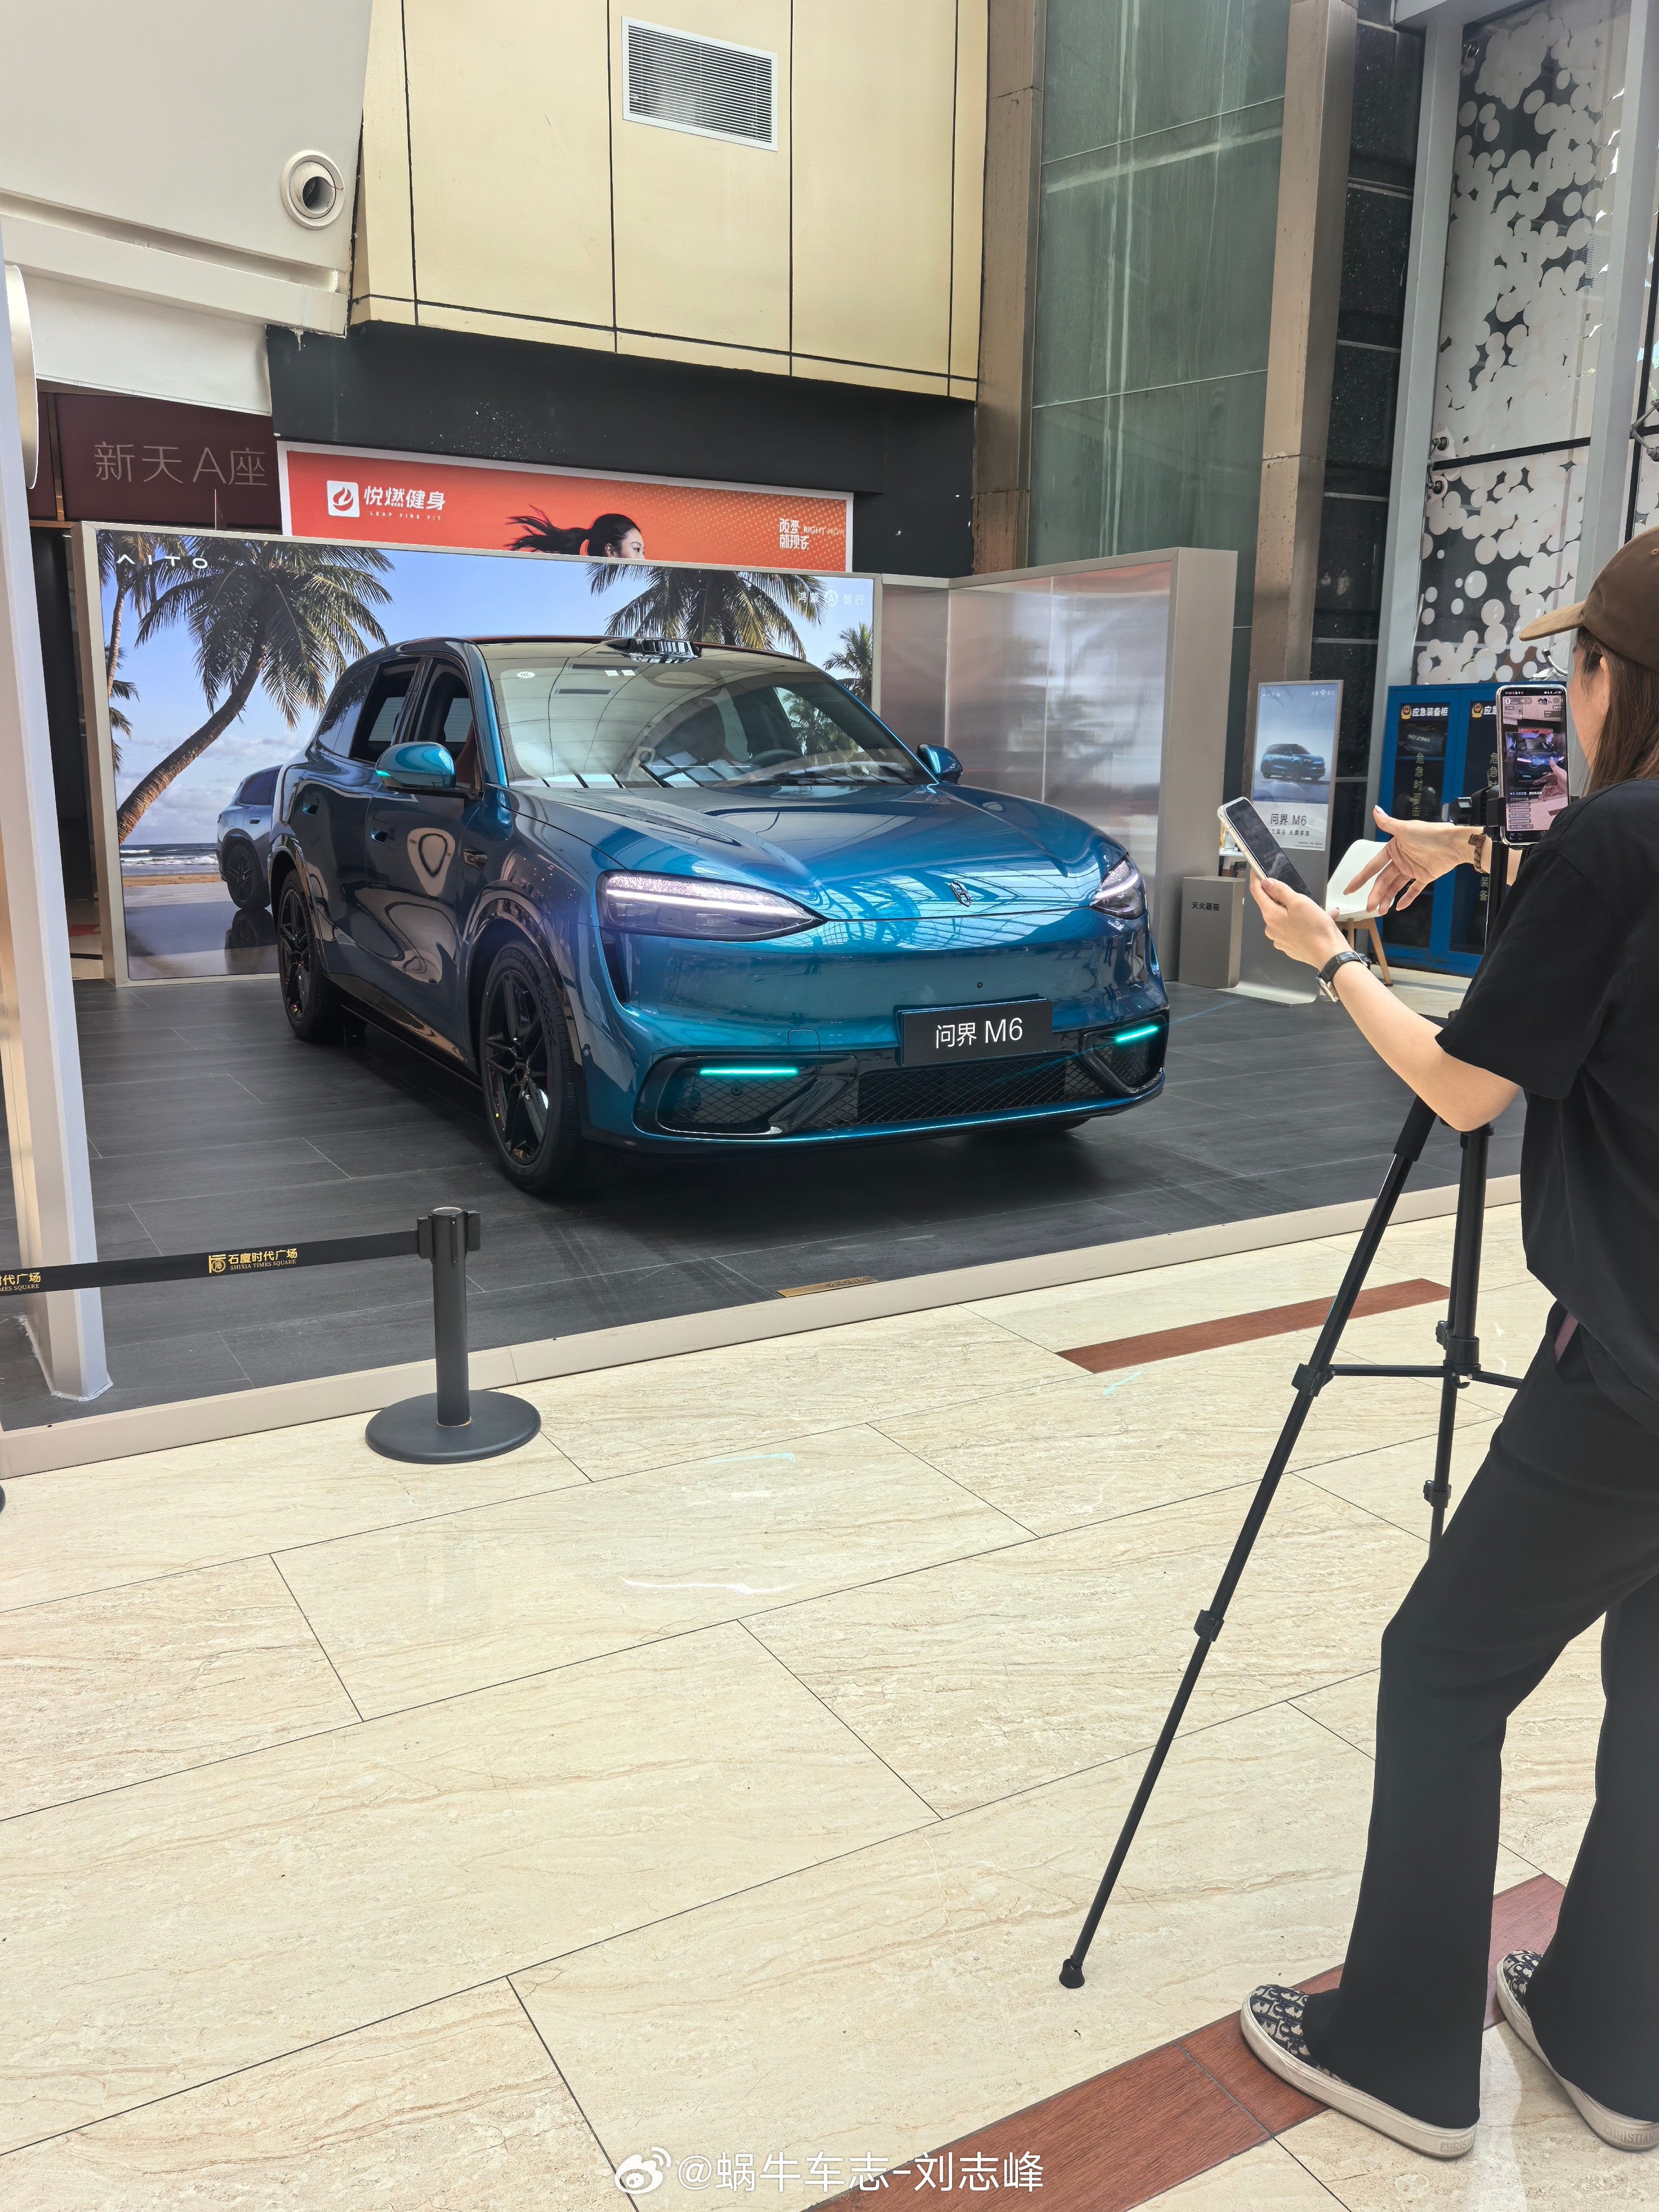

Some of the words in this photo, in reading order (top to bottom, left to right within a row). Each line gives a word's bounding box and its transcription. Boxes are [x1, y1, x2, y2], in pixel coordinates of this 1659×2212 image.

[94, 442, 268, 485] 新天A座
[363, 485, 446, 510] 悦燃健身
[779, 518, 800, 534] 改变
[803, 525, 826, 536] RIGHT
[827, 528, 845, 536] NOW
[116, 554, 208, 569] AITO
[843, 594, 864, 605] 智行
[1412, 707, 1449, 717] 应急装备柜
[1270, 813, 1288, 825] 问界
[1292, 815, 1307, 826] M6
[936, 1022, 977, 1049] 问界
[985, 1017, 1023, 1043] M6
[0, 1272, 41, 1286] 代广场
